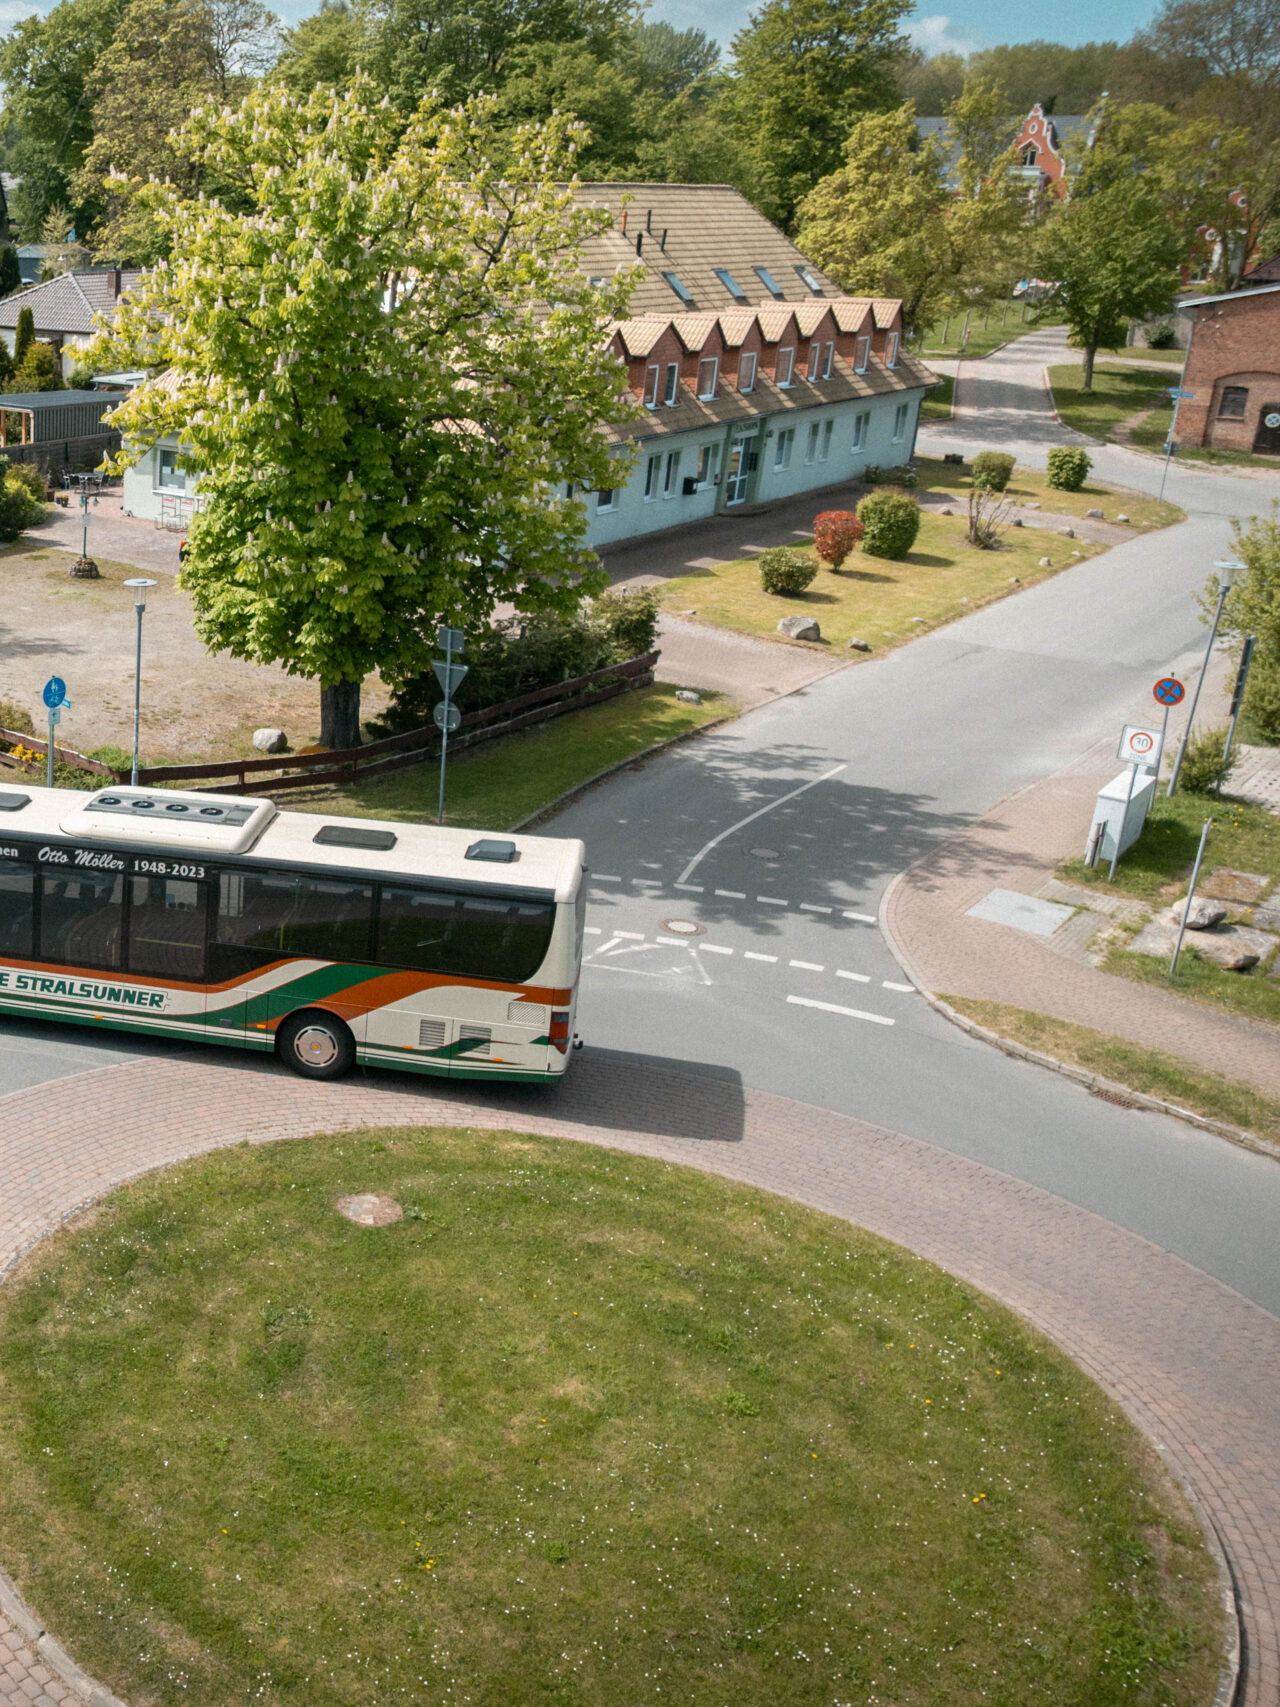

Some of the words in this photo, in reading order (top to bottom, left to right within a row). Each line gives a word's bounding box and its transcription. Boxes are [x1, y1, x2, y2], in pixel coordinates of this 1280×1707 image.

[1135, 736, 1149, 748] 30
[37, 846, 69, 863] Otto
[74, 848, 126, 871] Möller
[133, 859, 205, 879] 1948-2023
[15, 974, 165, 1009] STRALSUNNER
